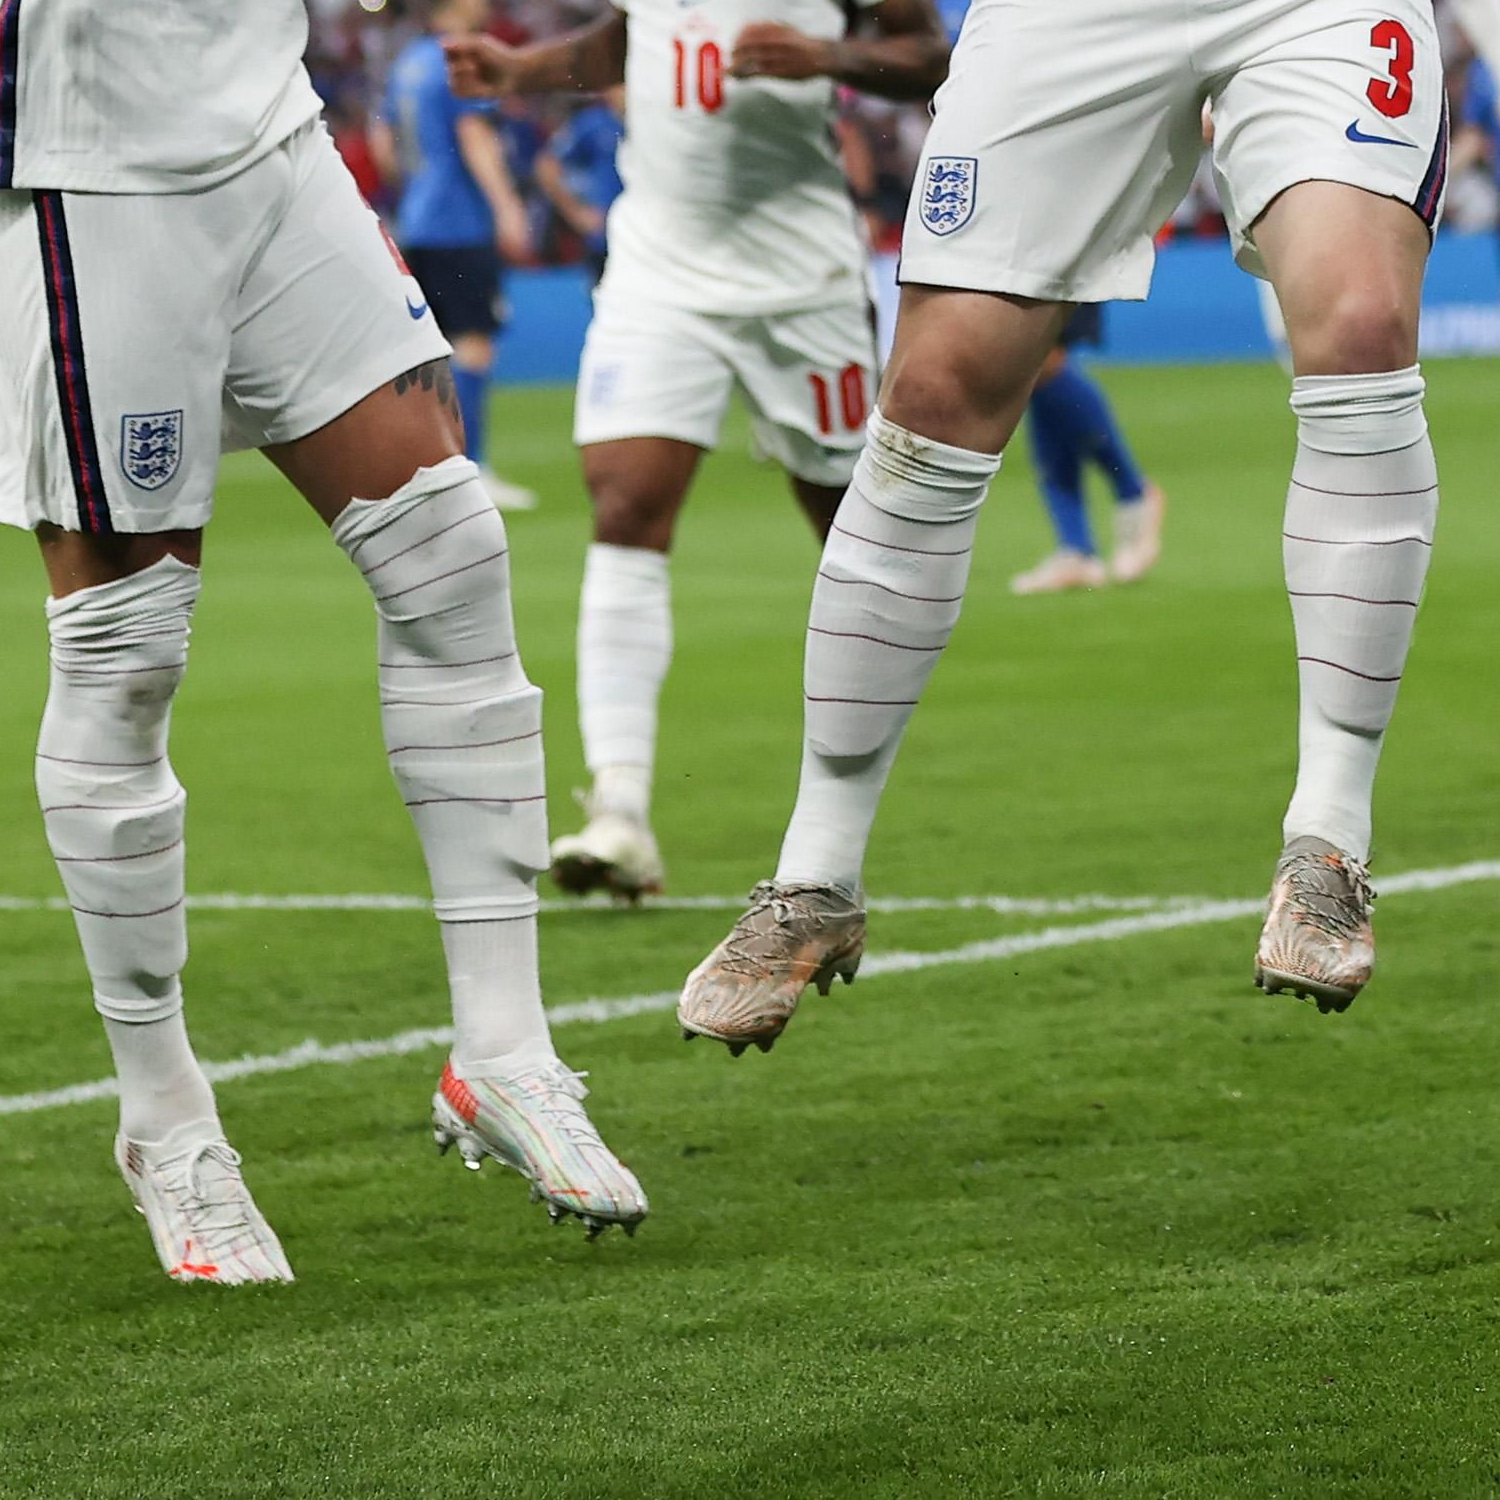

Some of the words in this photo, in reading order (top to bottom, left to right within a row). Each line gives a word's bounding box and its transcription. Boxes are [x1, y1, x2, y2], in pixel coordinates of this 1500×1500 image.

[674, 37, 723, 115] 10
[1366, 19, 1414, 119] 3
[808, 362, 867, 435] 10
